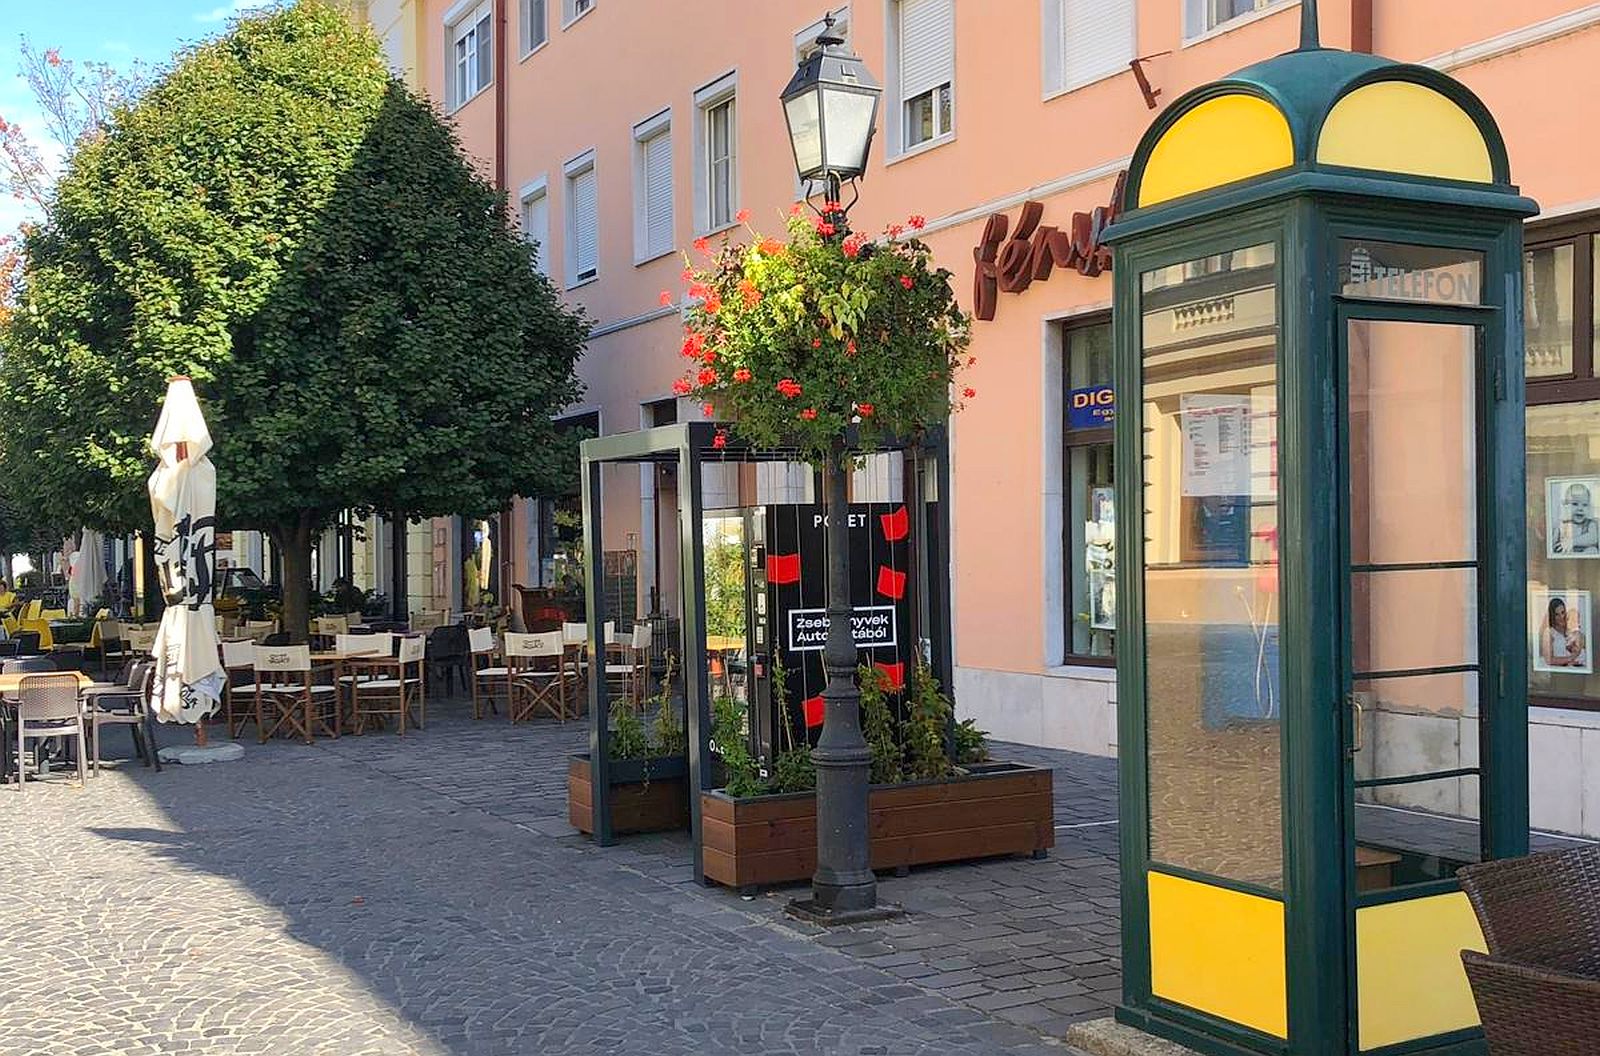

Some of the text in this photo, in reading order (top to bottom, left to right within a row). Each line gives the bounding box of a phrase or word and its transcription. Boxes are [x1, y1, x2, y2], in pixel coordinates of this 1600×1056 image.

[1374, 266, 1473, 302] TELEFON
[796, 614, 889, 629] Zsebnyvek
[796, 626, 887, 642] Autotából
